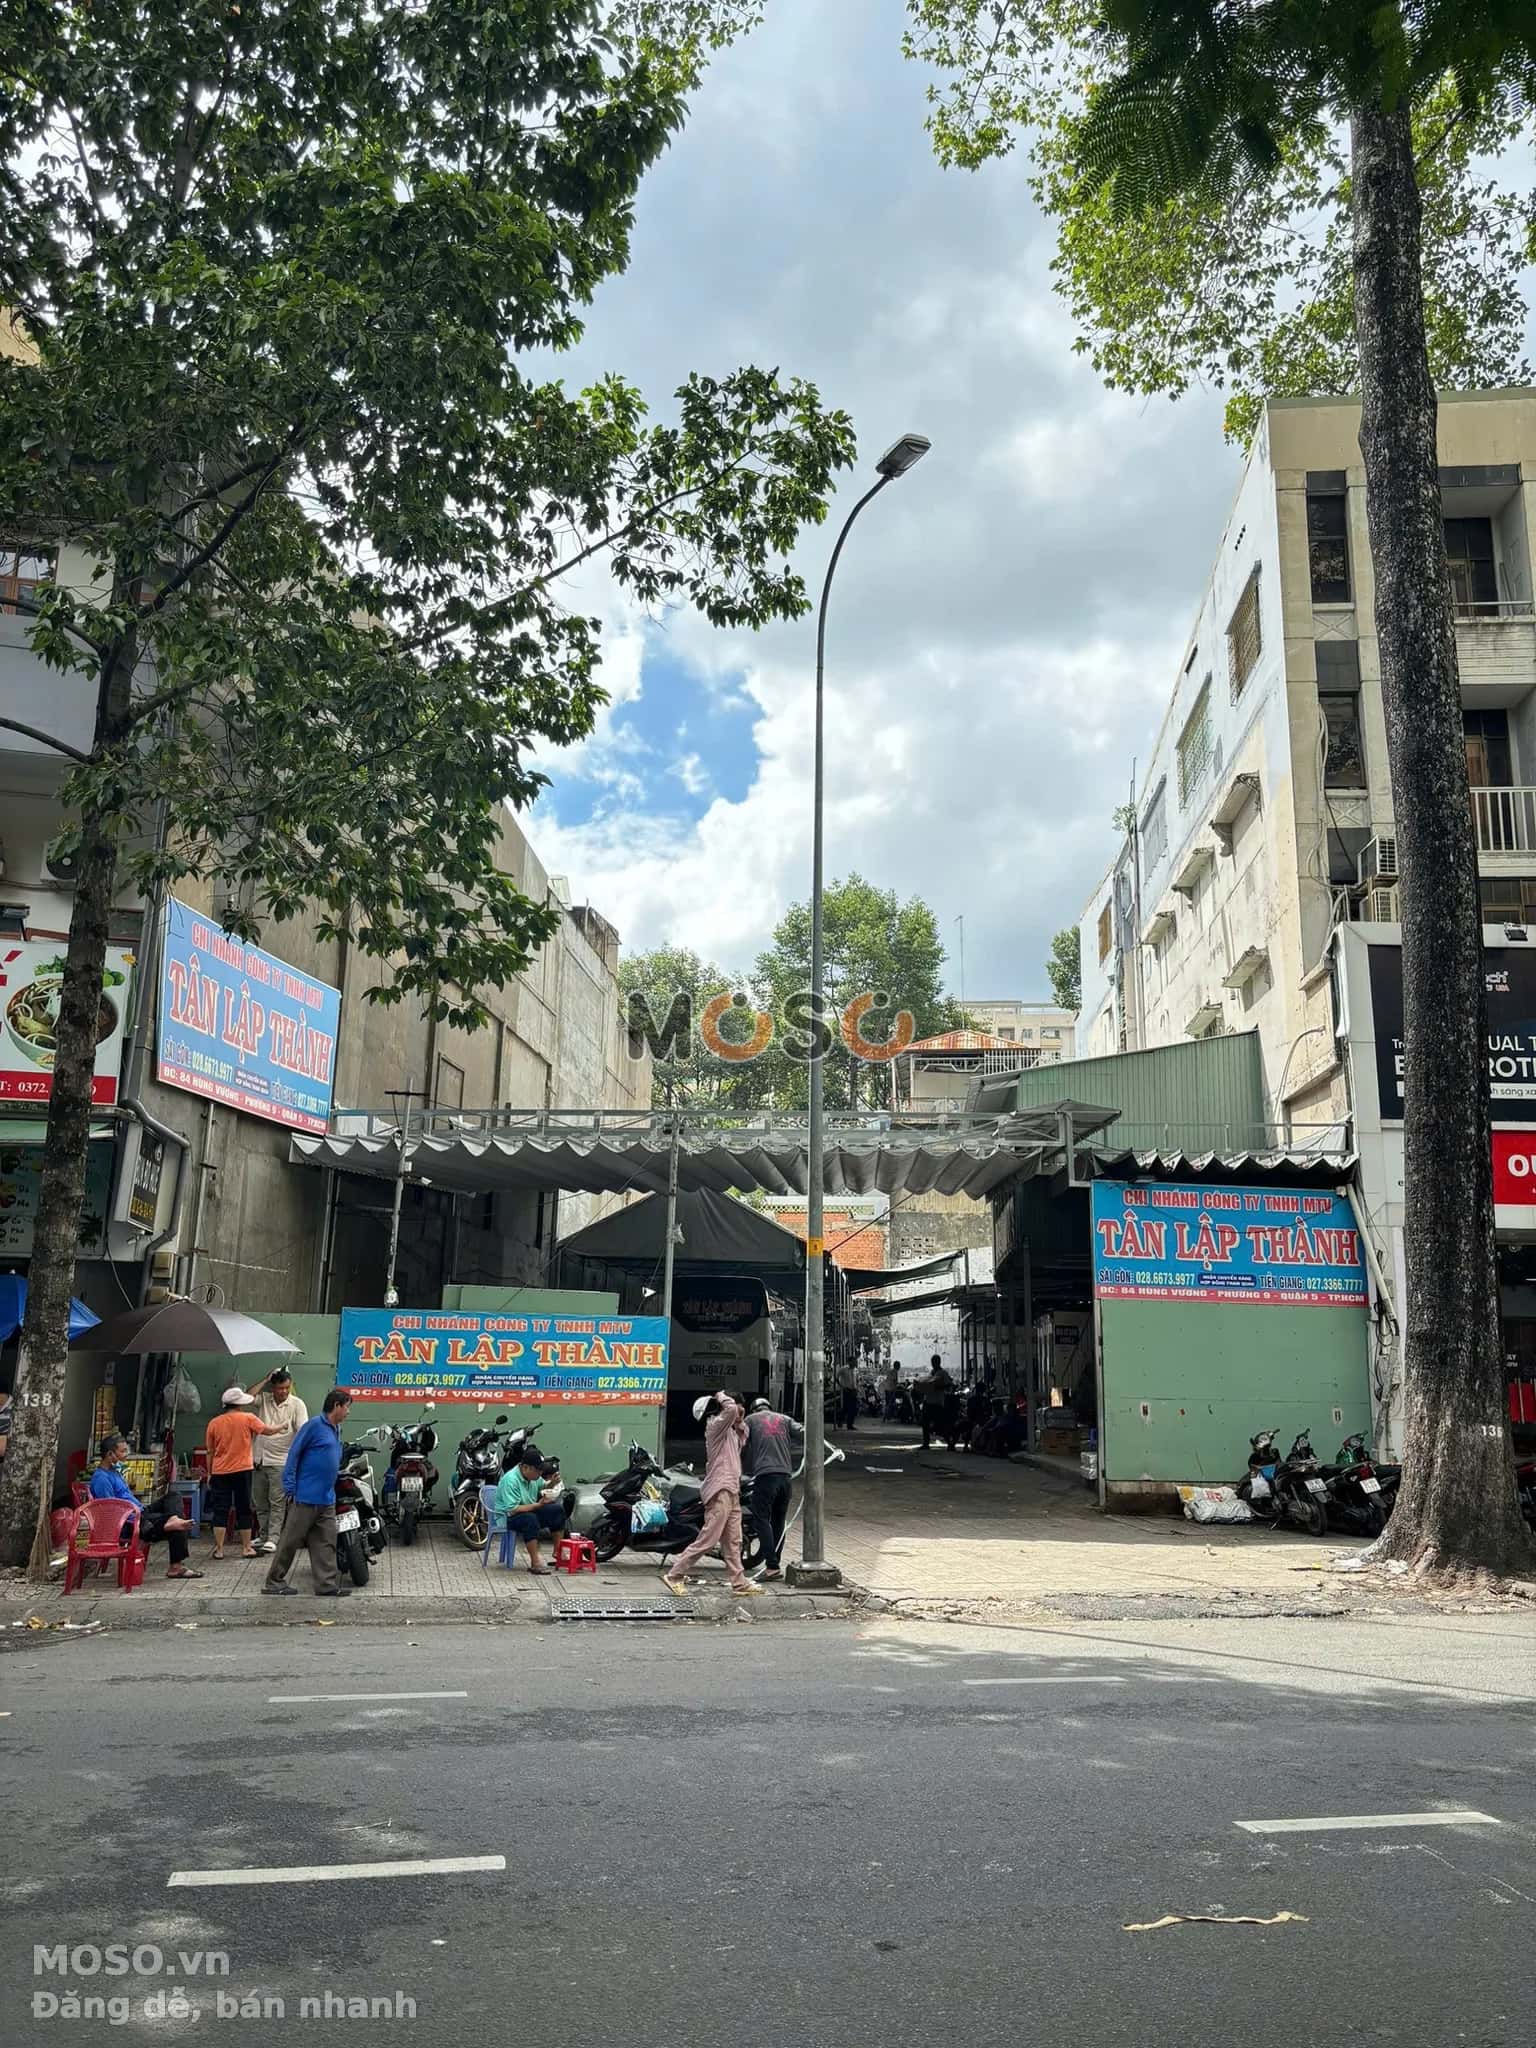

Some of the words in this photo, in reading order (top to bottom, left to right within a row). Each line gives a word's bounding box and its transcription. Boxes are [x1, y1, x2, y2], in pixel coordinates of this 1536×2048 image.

[168, 952, 219, 1039] TÂN
[222, 979, 266, 1065] LẬP
[268, 1007, 333, 1085] THÀNH
[1123, 1188, 1149, 1206] CHI
[1152, 1188, 1200, 1208] NHÁNH
[1202, 1190, 1241, 1210] CÔNG
[1244, 1194, 1261, 1211] TY
[1263, 1195, 1300, 1213] TNHH
[1303, 1196, 1333, 1214] MTV
[1097, 1208, 1167, 1260] TÂN
[1174, 1211, 1240, 1271] LẬP
[1246, 1215, 1360, 1267] THÀNH
[1135, 1271, 1195, 1286] 028.6673.9977
[1306, 1278, 1363, 1291] 027.3366.7777
[1121, 1286, 1136, 1294] 84
[1263, 1291, 1271, 1299] 9
[1311, 1292, 1319, 1300] 5
[393, 1315, 422, 1329] CHI
[426, 1314, 480, 1331] NHÁNH
[484, 1316, 528, 1333] CÔNG
[532, 1318, 551, 1333] TY
[555, 1319, 596, 1334] TNHH
[600, 1320, 633, 1335] MTV
[354, 1329, 439, 1365] TÂN
[446, 1332, 525, 1371] LẬP
[531, 1334, 666, 1369] THÀNH
[394, 1372, 466, 1386] 028.6673.9977
[22, 1392, 52, 1407] 138
[382, 1388, 400, 1397] 84
[629, 1392, 664, 1400] HCM
